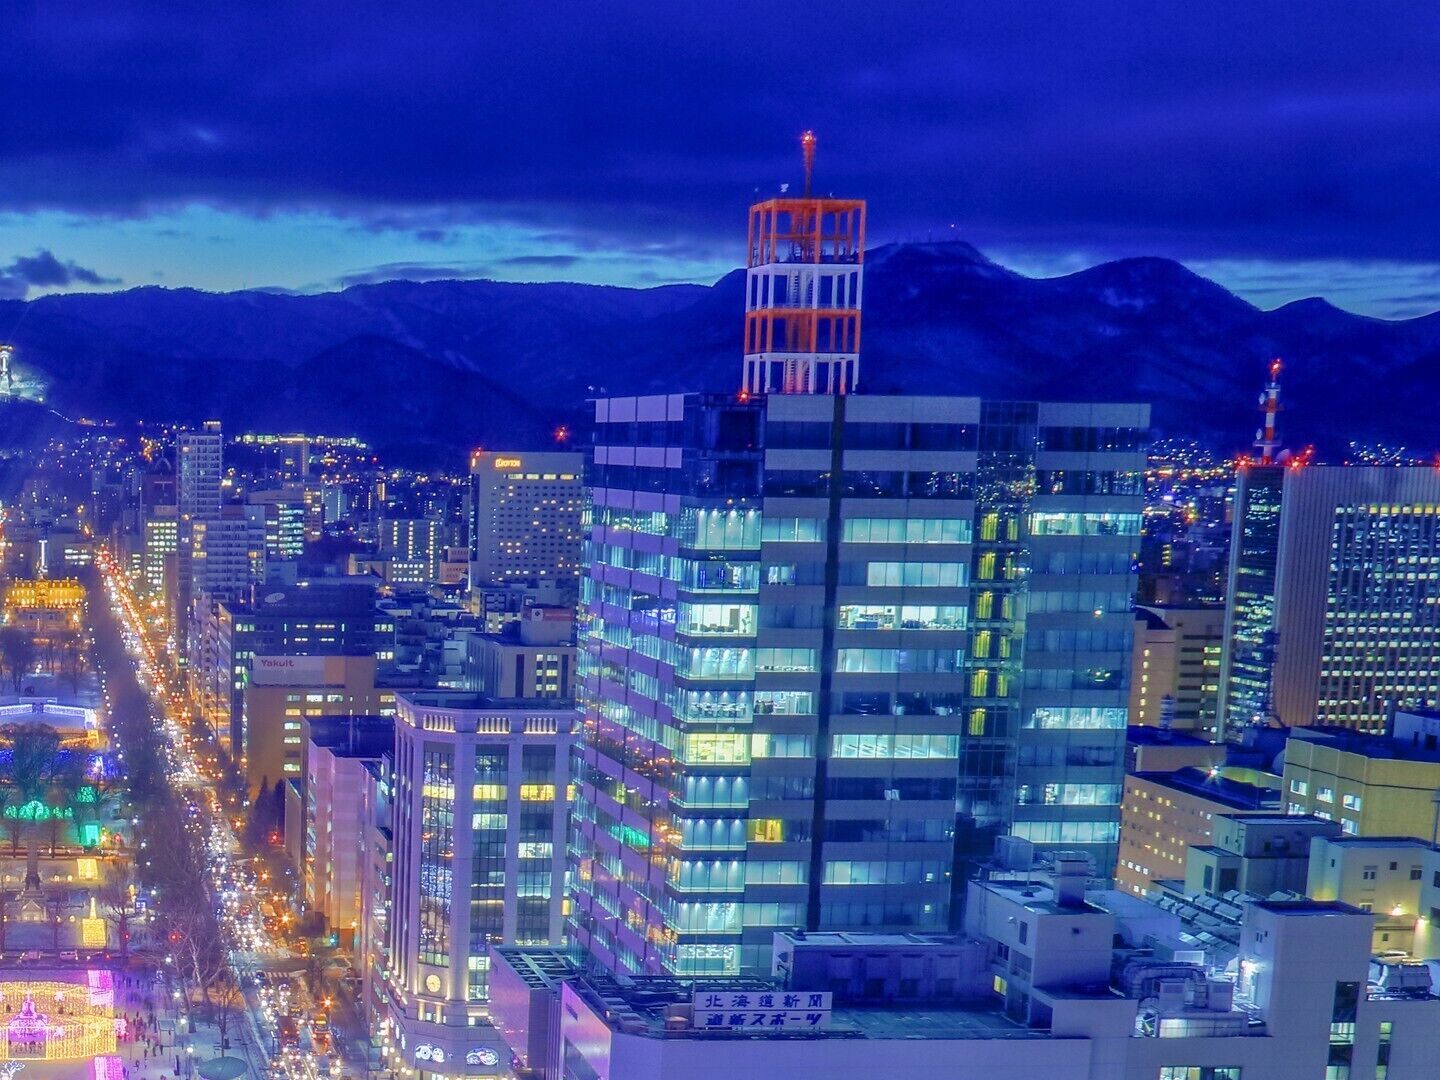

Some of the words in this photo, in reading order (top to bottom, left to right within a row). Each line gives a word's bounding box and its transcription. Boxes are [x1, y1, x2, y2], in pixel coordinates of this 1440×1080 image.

[261, 659, 295, 667] Yakult
[705, 994, 823, 1008] 北海道新聞
[705, 1012, 822, 1026] 道新スポーツ
